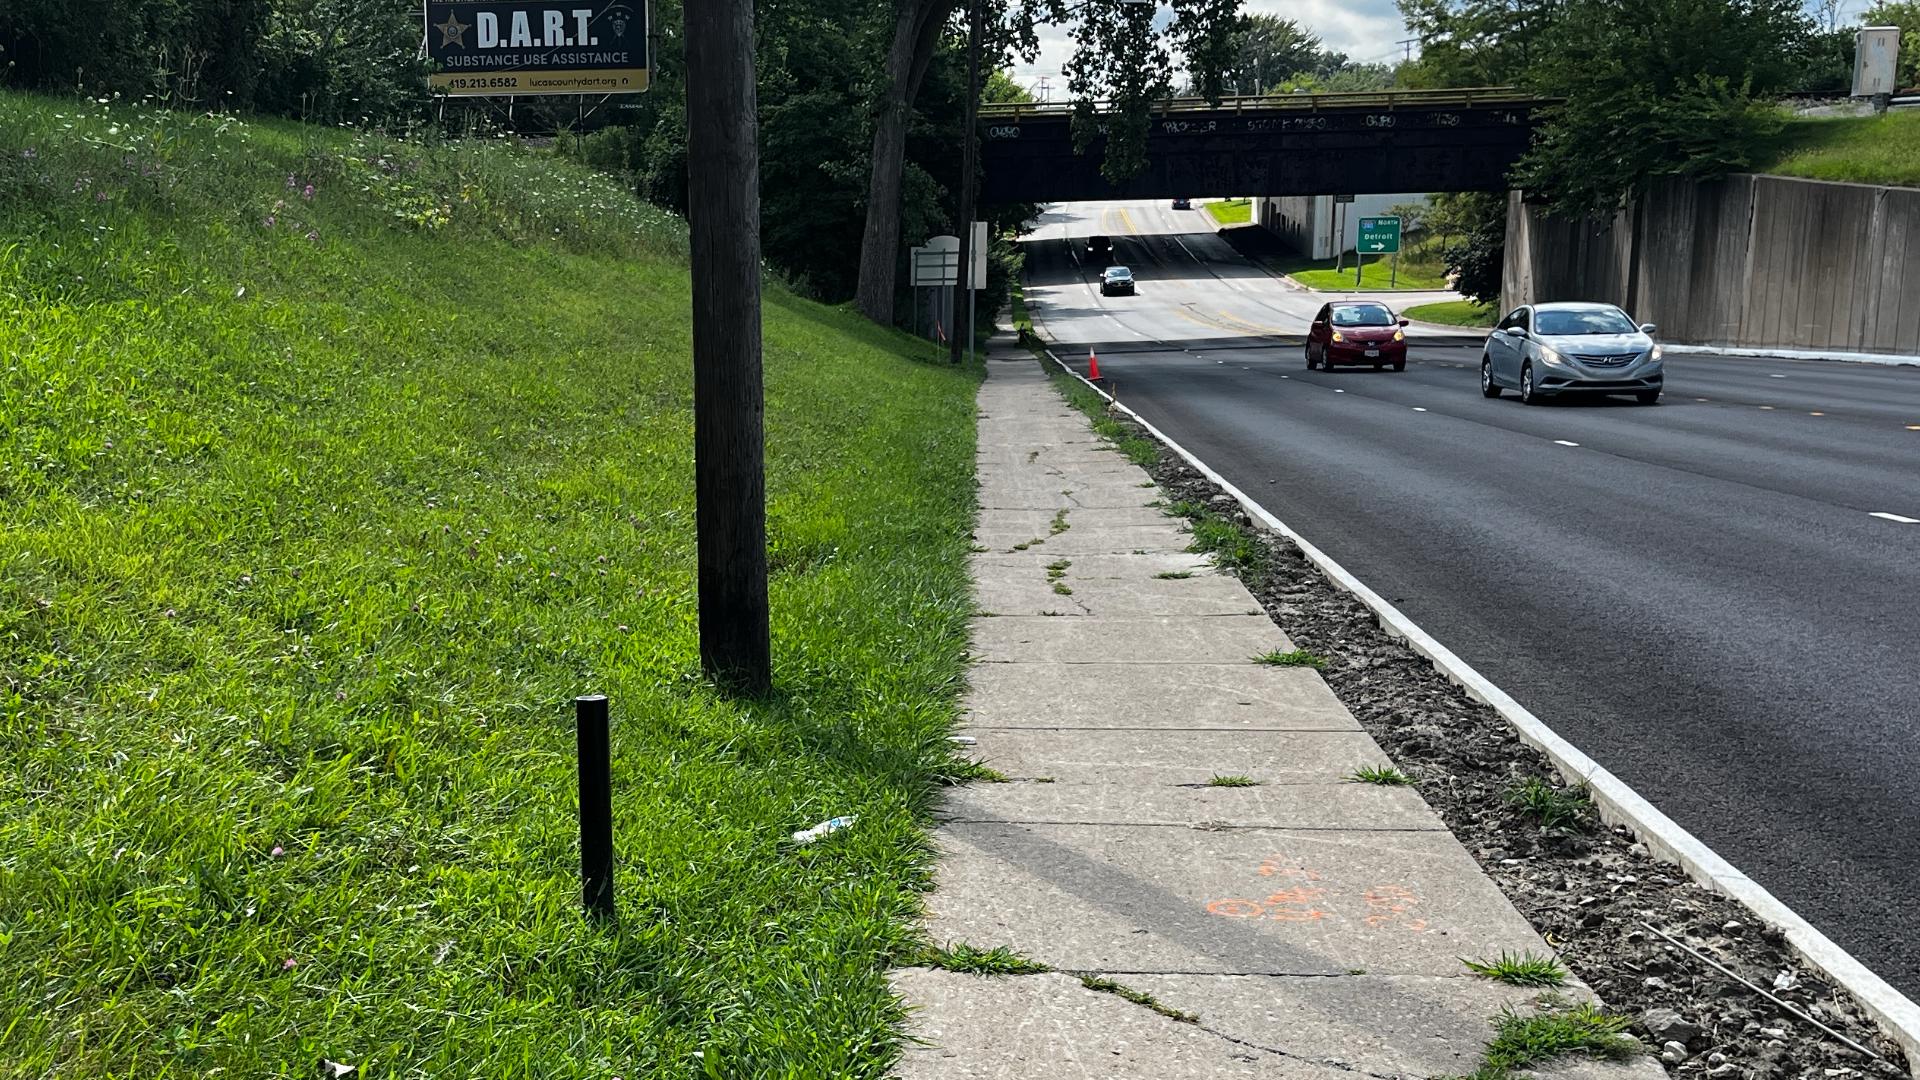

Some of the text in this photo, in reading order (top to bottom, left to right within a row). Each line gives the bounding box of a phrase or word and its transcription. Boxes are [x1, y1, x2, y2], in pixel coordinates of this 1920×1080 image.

[476, 9, 599, 49] D.A.R.T.
[446, 51, 629, 68] SUBSTANCE USE ASSISTANCE
[529, 77, 617, 89] lucascountydart.org
